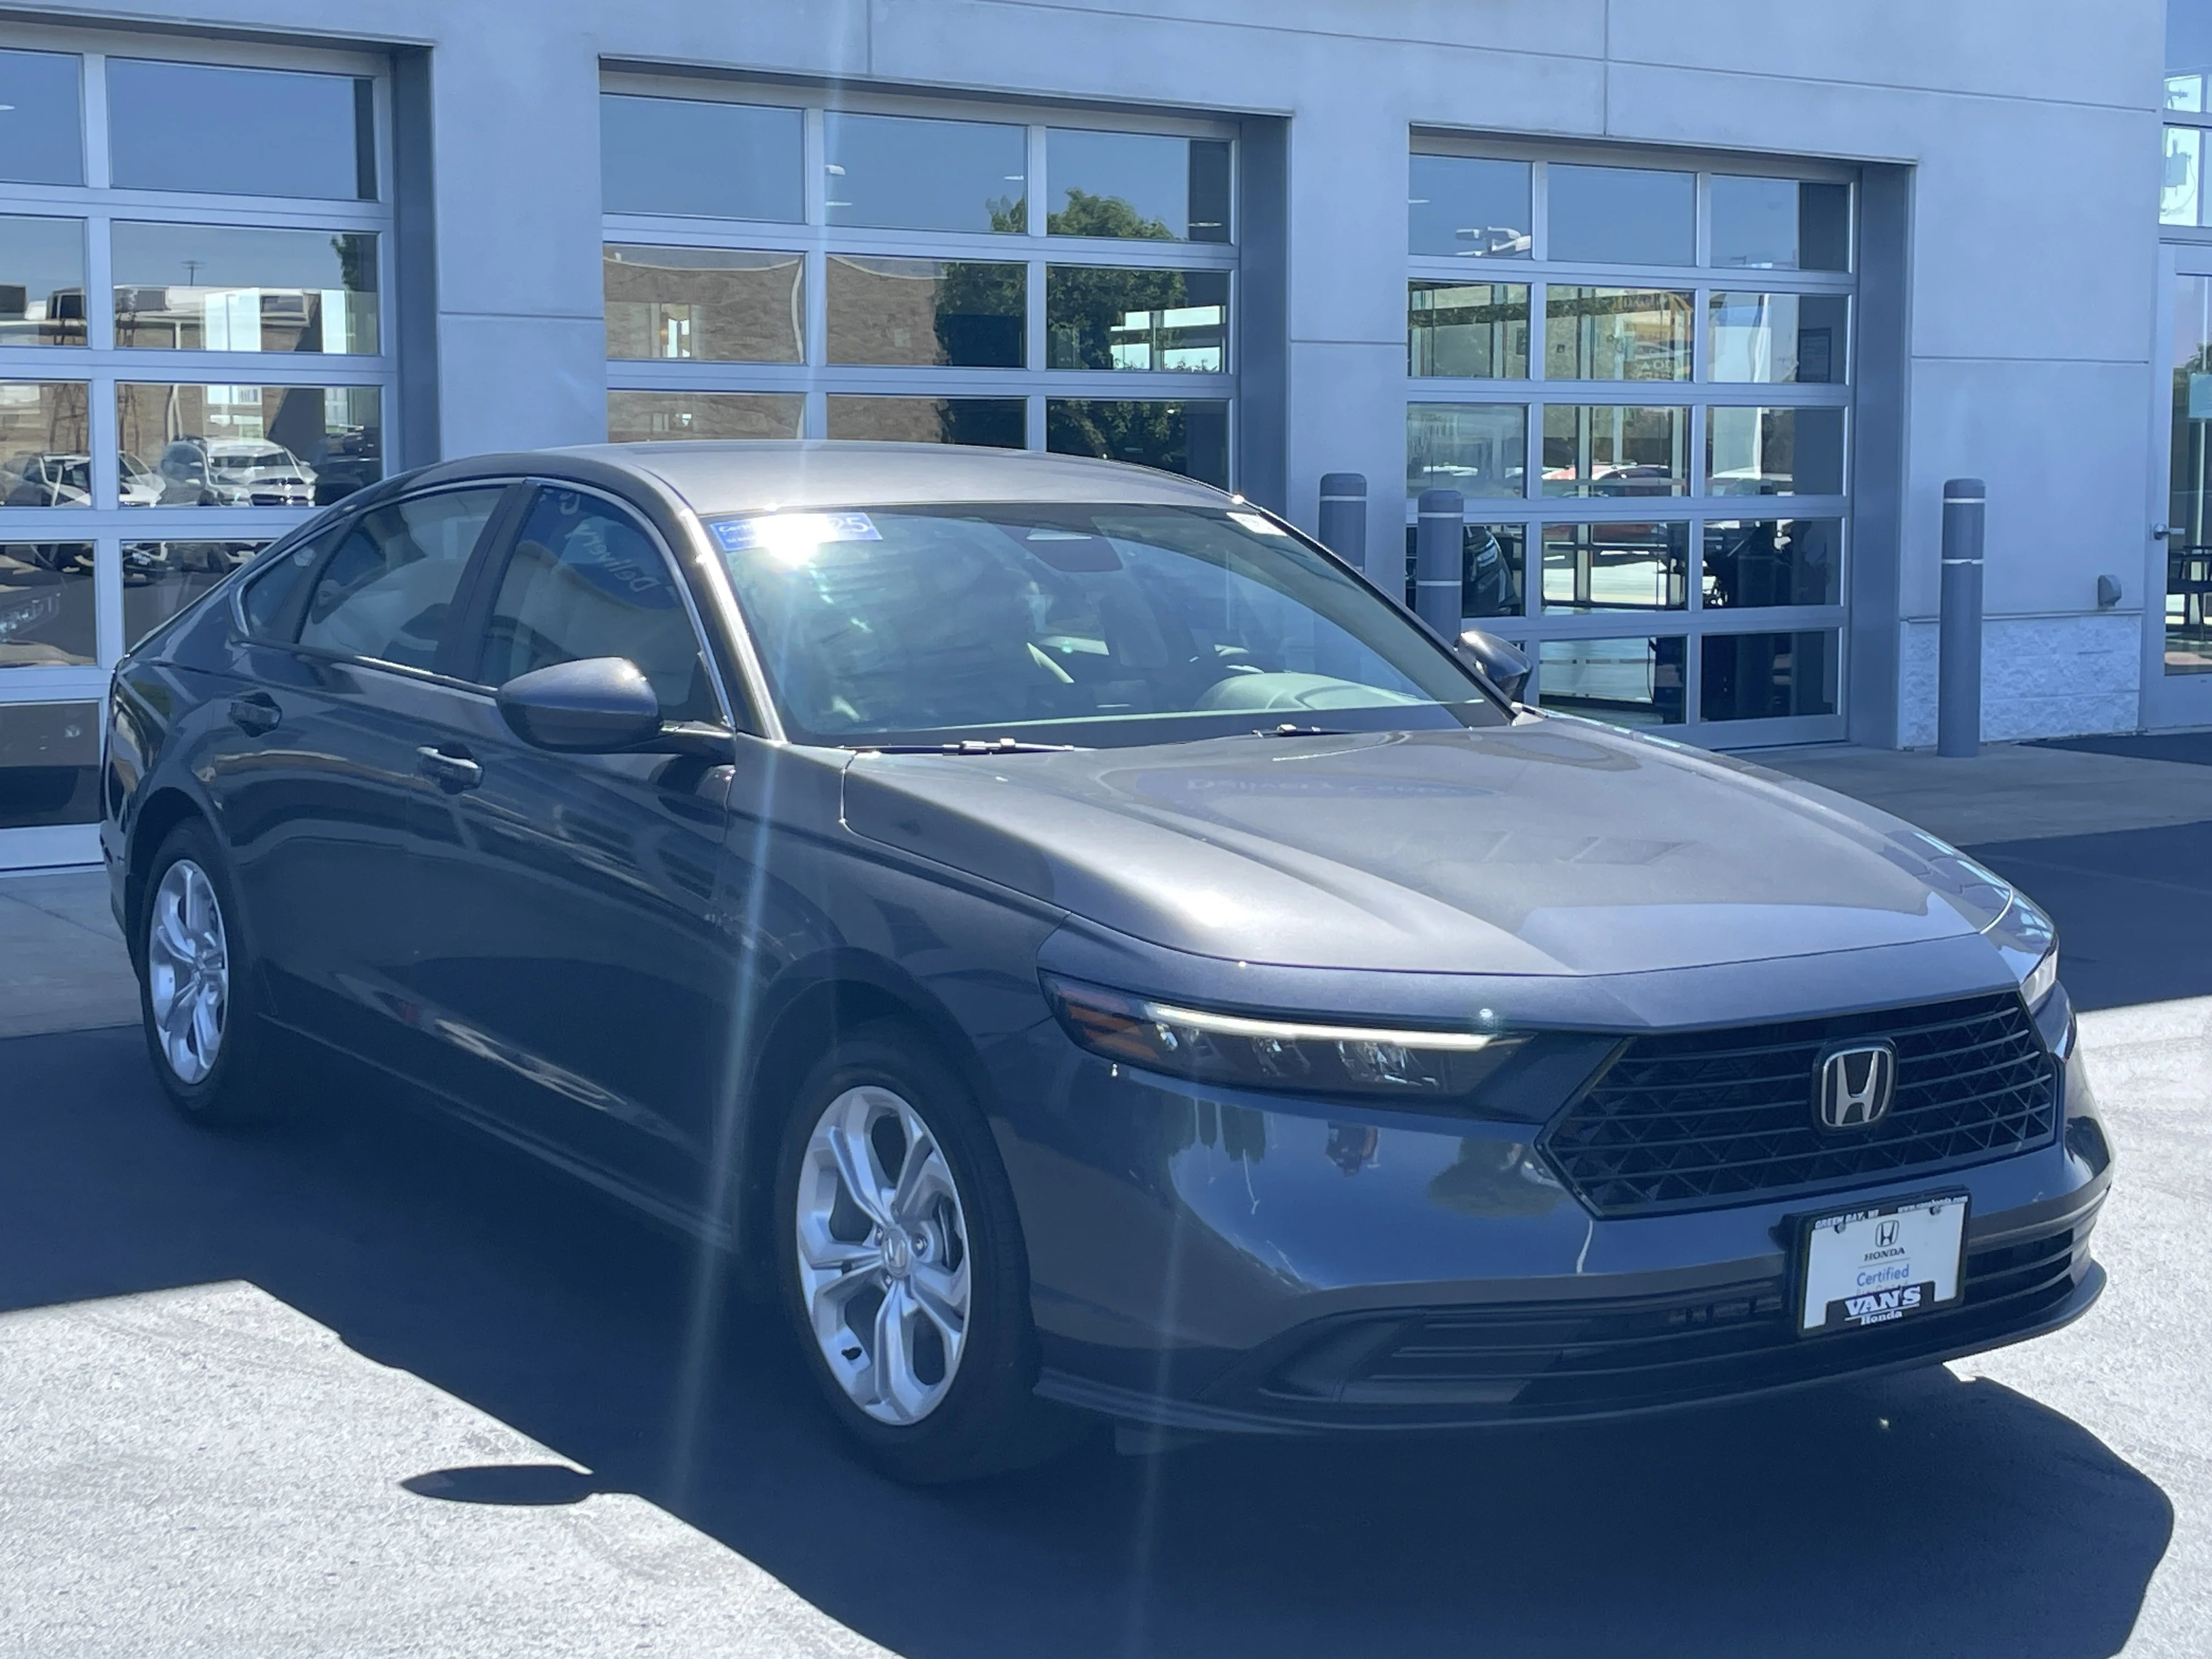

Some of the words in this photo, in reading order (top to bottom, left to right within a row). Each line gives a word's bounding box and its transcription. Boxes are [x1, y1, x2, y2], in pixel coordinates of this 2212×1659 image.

[1815, 1215, 1844, 1230] GREEN
[1864, 1246, 1905, 1261] HONDA
[1856, 1263, 1910, 1287] Certified
[1860, 1310, 1903, 1325] Honda
